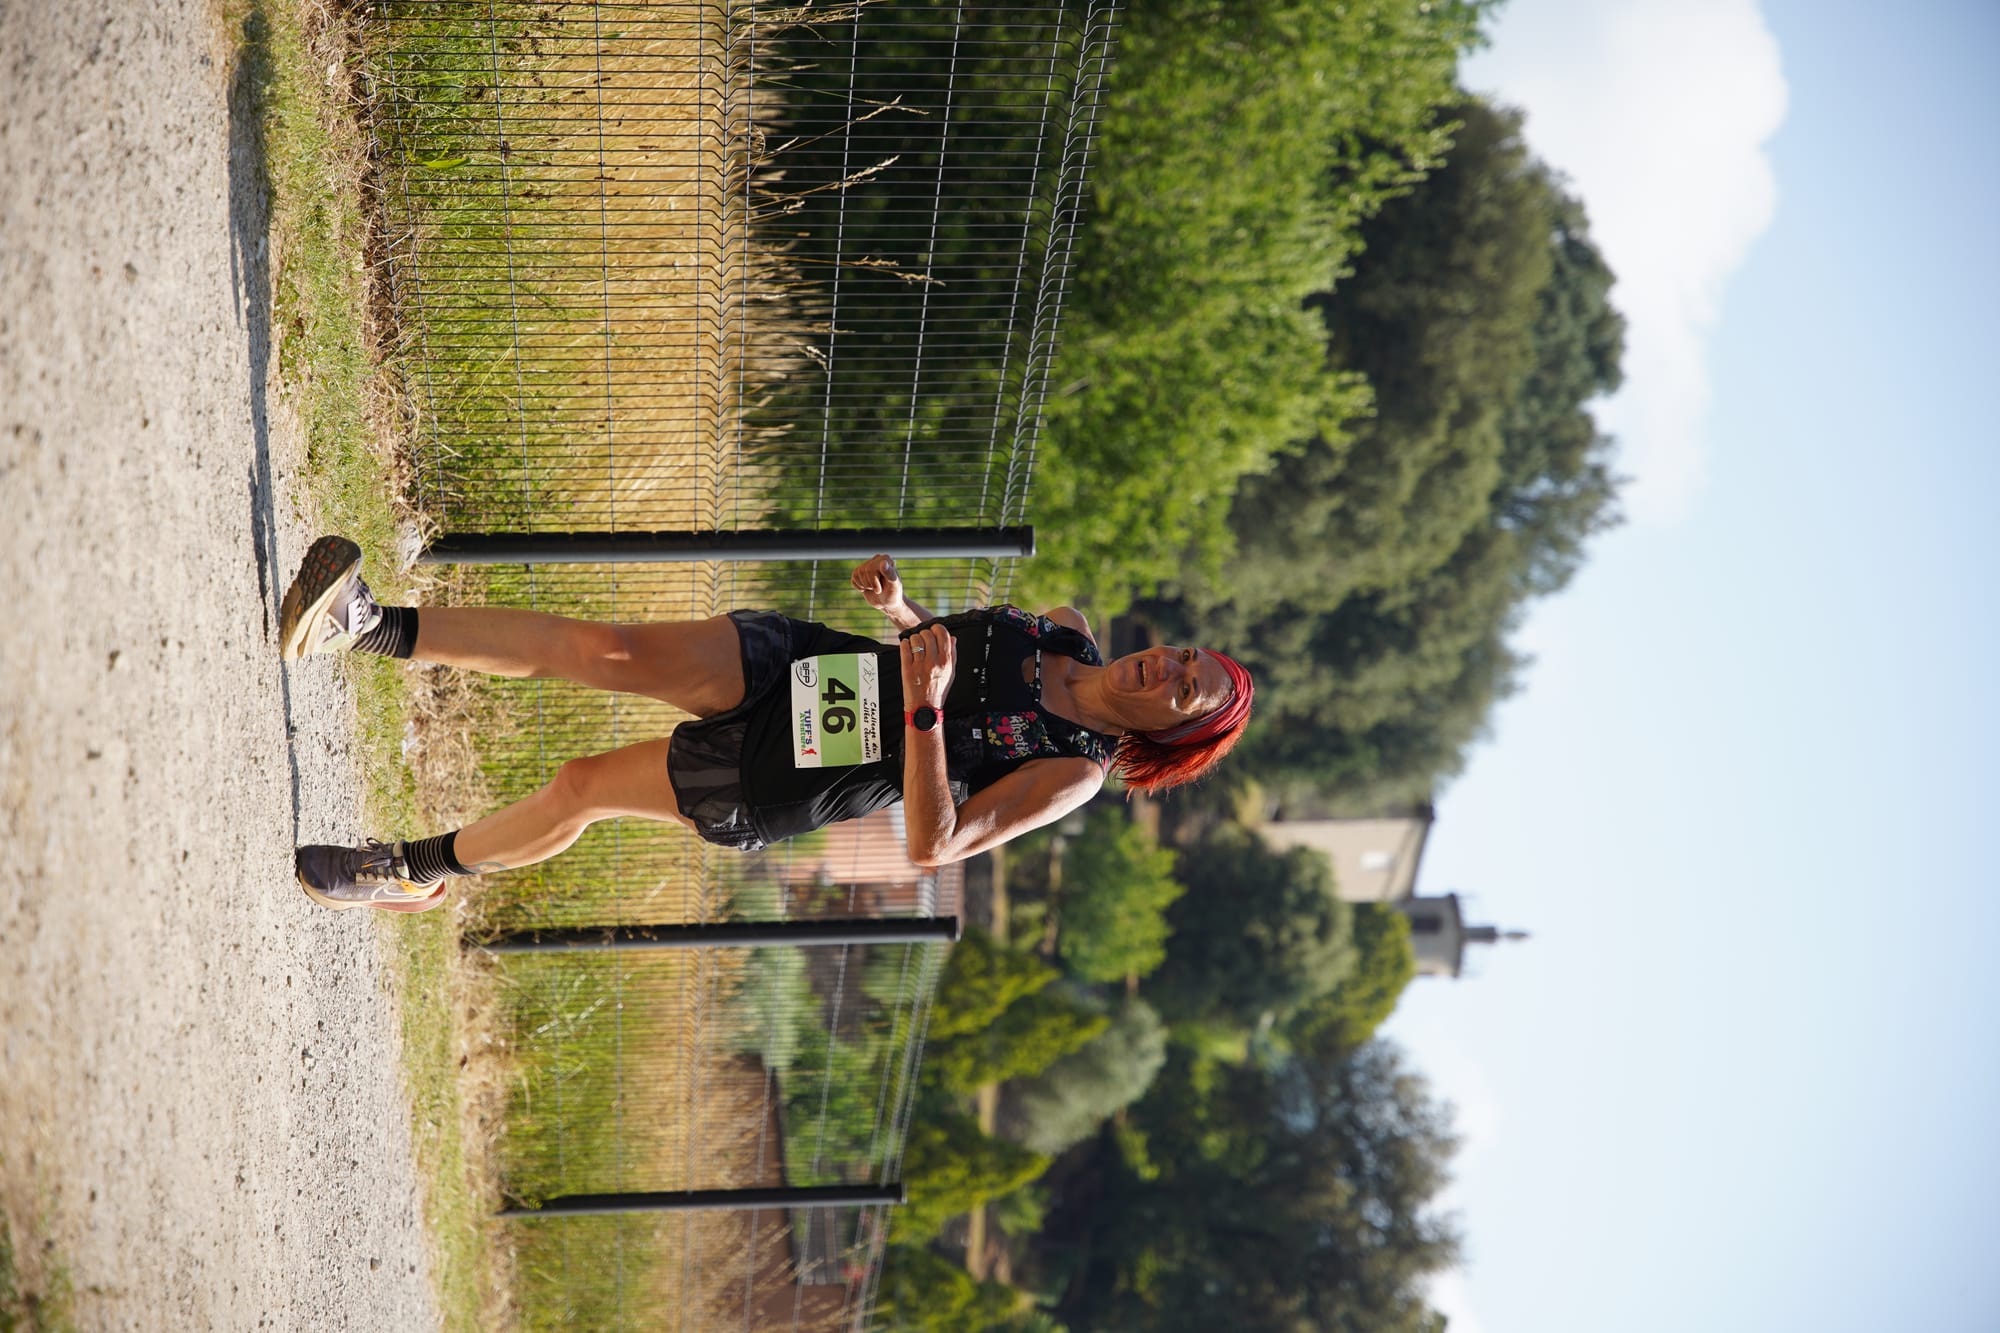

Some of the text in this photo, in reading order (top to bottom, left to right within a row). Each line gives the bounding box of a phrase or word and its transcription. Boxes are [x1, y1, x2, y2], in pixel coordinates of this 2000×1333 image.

[821, 677, 856, 734] 46
[869, 702, 877, 738] Challenge
[804, 708, 812, 744] TUFF'S
